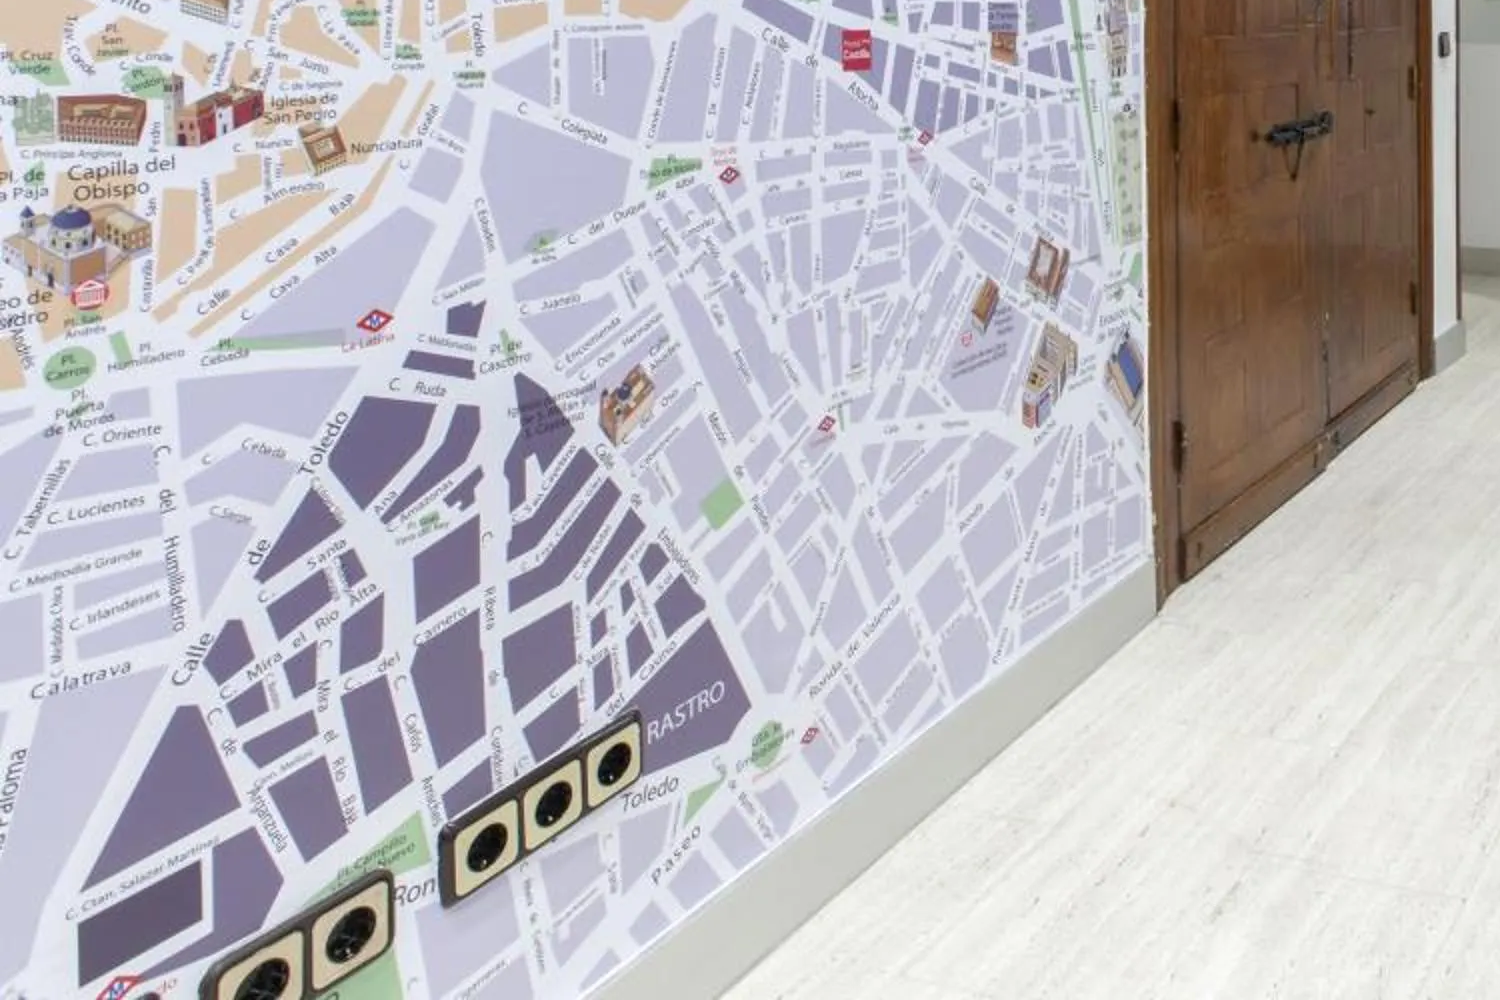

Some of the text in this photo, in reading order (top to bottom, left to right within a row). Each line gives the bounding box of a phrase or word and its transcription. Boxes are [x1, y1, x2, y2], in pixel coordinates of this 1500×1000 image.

[264, 111, 290, 125] San
[271, 92, 339, 109] Iglesia de
[67, 156, 177, 184] Capilla del
[13, 186, 49, 201] Paja
[73, 179, 150, 203] Obispo
[197, 192, 357, 316] Calle Cava Baja
[269, 245, 338, 300] Cava Alta
[107, 349, 187, 373] Humilladero
[200, 349, 250, 368] Cebada
[479, 353, 533, 375] Cascorro
[414, 381, 448, 398] Ruda
[44, 412, 117, 438] de Moros
[55, 400, 105, 421] Puerta
[102, 423, 163, 445] Oriente
[300, 411, 349, 476] Toledo
[15, 458, 72, 539] Tabernillas
[67, 494, 147, 522] Lucientes
[306, 489, 400, 569] Santa Ana
[94, 547, 144, 571] Grande
[248, 539, 272, 566] de
[165, 535, 188, 632] Humilladero
[87, 588, 161, 625] Irlandeses
[246, 582, 378, 681] Mira el Alta
[414, 606, 467, 647] Carnero
[172, 631, 216, 687] Calle
[639, 639, 677, 682] Casino
[31, 660, 132, 700] Calatrava
[647, 680, 725, 744] RASTRO
[620, 776, 681, 814] Toledo
[247, 788, 287, 854] Arganzuela
[651, 825, 702, 886] Paseo
